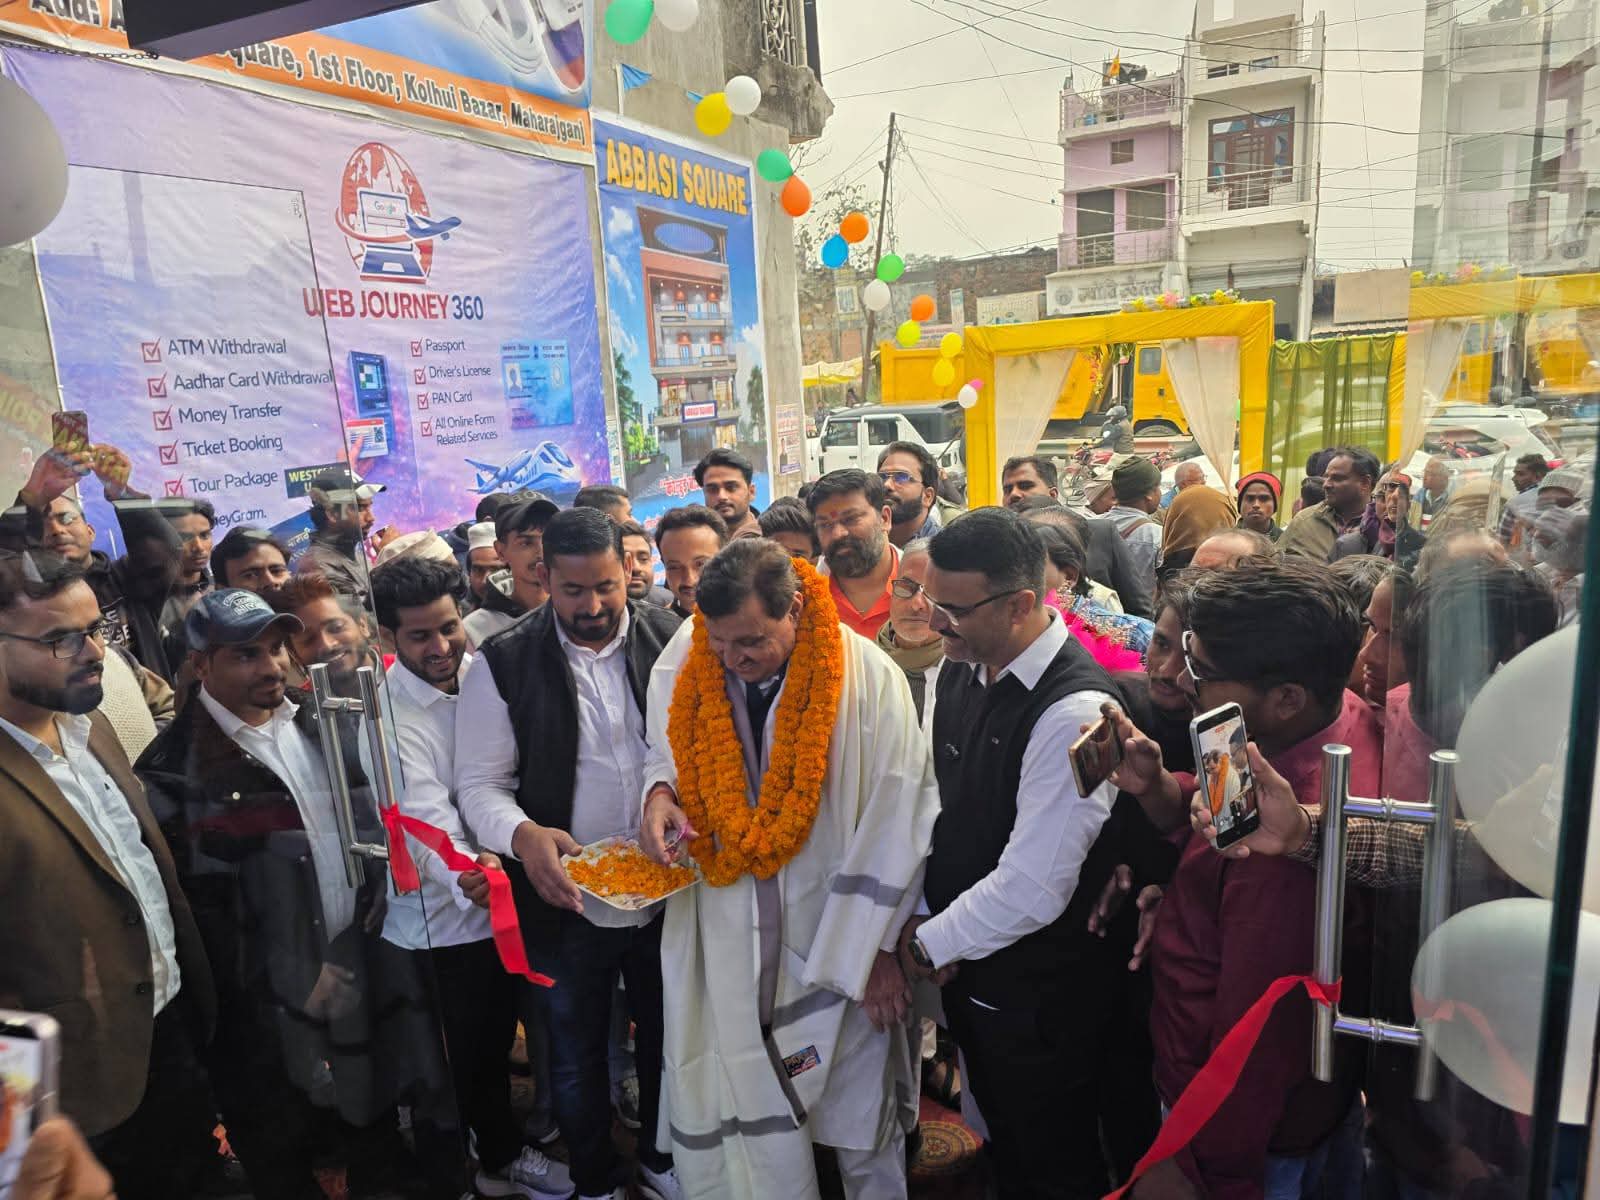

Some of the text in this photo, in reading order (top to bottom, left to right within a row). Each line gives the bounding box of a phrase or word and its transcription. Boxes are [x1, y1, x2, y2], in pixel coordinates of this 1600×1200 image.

[217, 41, 584, 146] quare, 1st Floor, Kolhui Bazar, Maharajganj
[606, 138, 749, 216] ABBASI SQUARE
[303, 287, 484, 321] WEB JOURNEY 360
[168, 338, 288, 356] ATM Withdrawal
[425, 339, 466, 355] Passport
[173, 368, 335, 390] Aadhar Card Withdrawal
[428, 365, 492, 379] Driver's License
[431, 391, 473, 404] PAN Card
[177, 401, 283, 424] Money Transfer
[435, 414, 495, 429] All Online Form
[182, 434, 284, 457] Ticket Booking
[436, 430, 498, 446] Related Services
[188, 470, 279, 493] Tour Package
